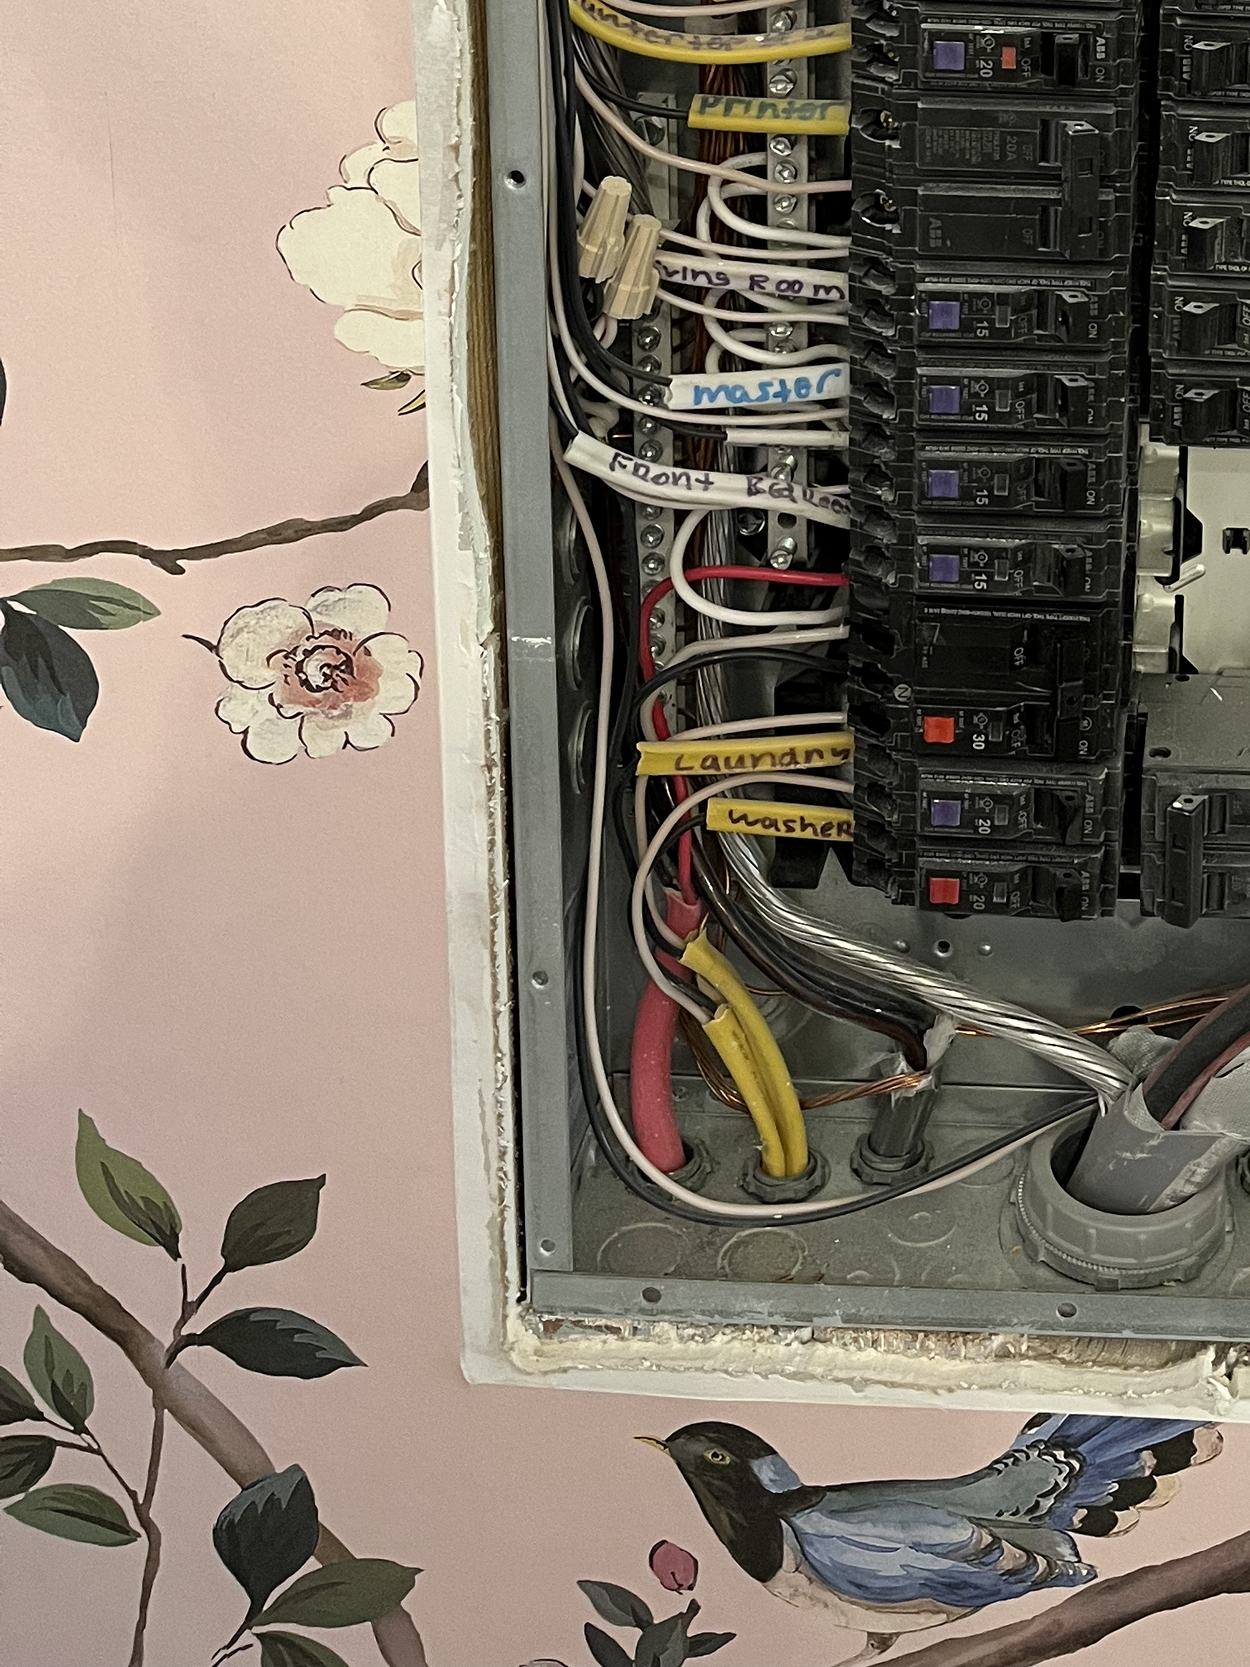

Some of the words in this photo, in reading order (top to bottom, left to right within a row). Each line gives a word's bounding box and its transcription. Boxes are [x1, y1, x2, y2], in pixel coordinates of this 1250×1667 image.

[1095, 37, 1106, 60] ABB
[1184, 35, 1194, 51] ON
[980, 60, 993, 78] 20
[1021, 58, 1032, 78] OFF
[1095, 66, 1105, 83] ON
[1182, 57, 1192, 81] ABB
[1005, 136, 1017, 162] 20A
[1022, 143, 1033, 161] OFF
[929, 217, 942, 248] ABB
[1174, 296, 1185, 312] ON
[976, 320, 989, 337] 15
[1017, 316, 1028, 335] OFF
[1088, 323, 1098, 339] ON
[975, 404, 988, 422] 15
[1015, 400, 1025, 420] OFF
[976, 489, 989, 506] 15
[1086, 490, 1096, 505] ON
[974, 573, 987, 591] 15
[1013, 570, 1024, 588] OFF
[1014, 647, 1026, 666] OFF
[972, 734, 985, 750] 30
[1079, 740, 1089, 755] ON
[978, 819, 991, 834] 20
[1084, 819, 1094, 834] ON
[973, 894, 986, 910] 20
[1010, 891, 1021, 909] OFF
